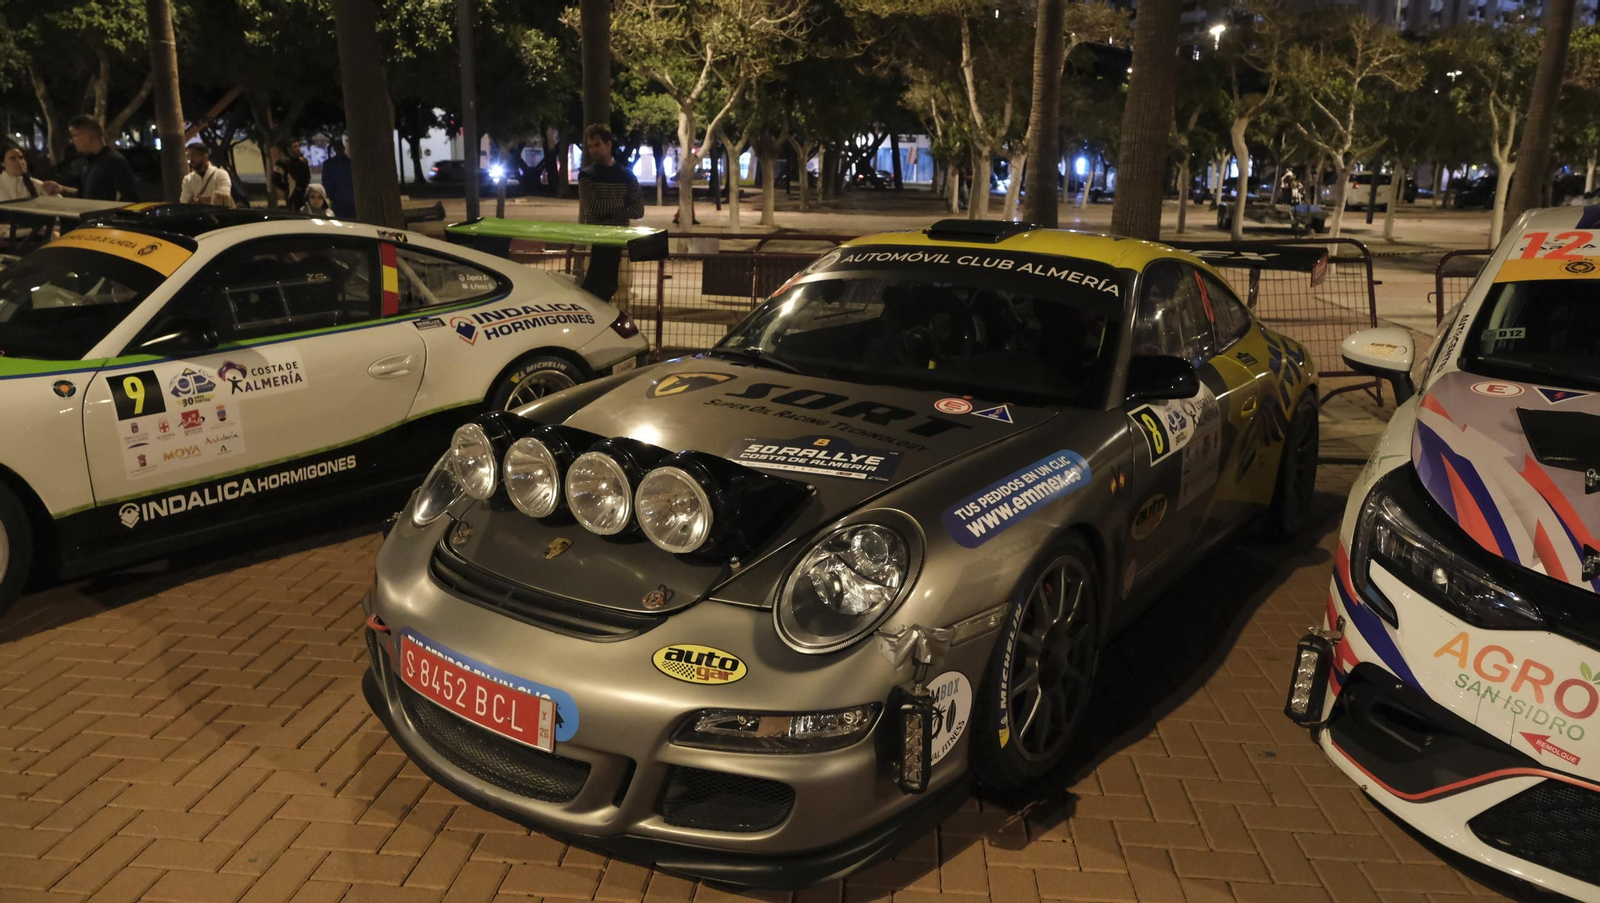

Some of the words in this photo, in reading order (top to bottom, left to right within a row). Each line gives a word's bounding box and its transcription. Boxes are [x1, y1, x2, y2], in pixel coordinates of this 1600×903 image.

[1520, 231, 1594, 259] 12
[840, 251, 950, 264] AUTOMÓVIL
[956, 255, 1015, 270] CLUB
[1016, 262, 1120, 297] ALMERÍA
[471, 303, 587, 325] INDALICA
[483, 314, 595, 340] HORMIGONES
[251, 363, 284, 377] COSTA
[285, 361, 299, 371] DE
[526, 361, 567, 374] MICHELIN
[245, 371, 303, 392] ALMERÍA
[122, 376, 146, 415] 9
[182, 397, 194, 407] 30
[724, 382, 974, 438] SORT
[703, 399, 750, 411] SUPER
[749, 405, 769, 415] OIL
[773, 409, 830, 426] RACING
[830, 422, 930, 452] TECHNOLOGY
[1141, 413, 1164, 454] 8
[163, 445, 201, 461] MOYA
[744, 444, 779, 454] 50
[777, 446, 885, 466] RALLYE
[813, 438, 831, 446] 8
[740, 453, 787, 462] COSTA
[810, 458, 877, 472] ALMERÍA
[141, 478, 257, 521] INDALICA
[257, 455, 357, 492] HORMIGONES
[954, 502, 981, 520] TUS
[977, 478, 1025, 508] PEDIDOS
[1020, 472, 1040, 484] EN
[1034, 464, 1053, 477] UN
[1048, 456, 1071, 470] CLIC
[966, 467, 1082, 538] www.emmex.es
[664, 647, 740, 672] auto
[1000, 603, 1022, 709] MICHELIN
[696, 667, 734, 681] gar
[1433, 631, 1599, 720] AGRO
[406, 650, 415, 678] S
[420, 659, 467, 708] 8452
[475, 685, 524, 732] BCL
[1454, 673, 1501, 704] SAN
[1503, 695, 1586, 741] ISIDRO
[539, 727, 549, 738] 26
[942, 720, 965, 753] FITNESS
[1535, 739, 1578, 764] REMOLQUE
